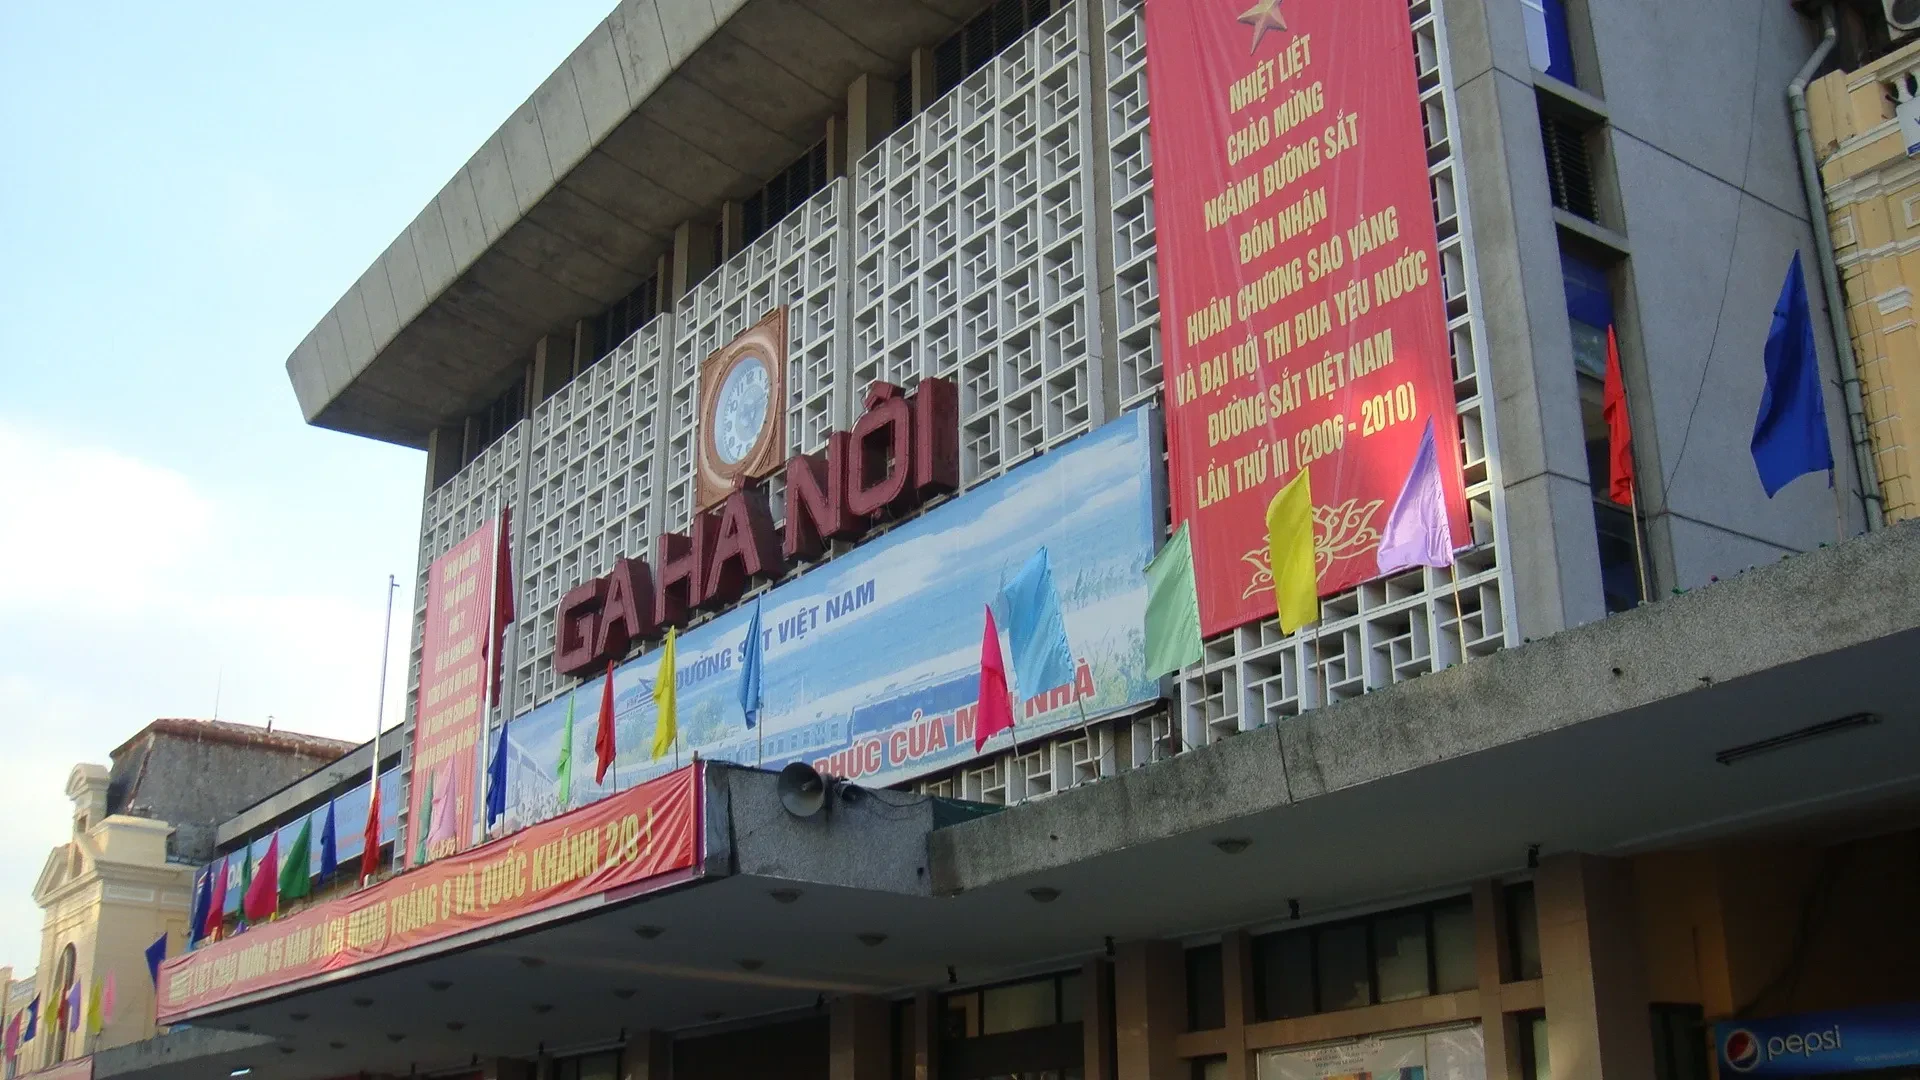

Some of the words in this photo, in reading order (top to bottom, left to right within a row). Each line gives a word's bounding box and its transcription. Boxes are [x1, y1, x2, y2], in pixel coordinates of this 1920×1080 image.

[1227, 115, 1270, 166] CHÀO
[1273, 81, 1324, 138] MỪNG
[1229, 59, 1274, 114] NHIỆT
[1278, 33, 1311, 83] LIỆT
[1204, 172, 1260, 232] NGÀNH
[1263, 136, 1321, 198] ĐƯỜNG
[1324, 108, 1358, 159] SẮT
[1187, 296, 1232, 347] HUÂN
[1237, 258, 1304, 322] CHƯƠNG
[1306, 234, 1344, 283] SAO
[1347, 205, 1399, 261] VÀNG
[1239, 217, 1276, 265] ĐÓN
[1278, 186, 1327, 244] NHẬN
[1175, 362, 1198, 407] VÀ
[1200, 352, 1229, 396] ĐẠI
[1232, 333, 1260, 381] HỘI
[1263, 320, 1292, 364] THI
[1294, 300, 1332, 349] ĐUA
[1334, 278, 1370, 327] YÊU
[1374, 246, 1429, 308] NƯỚC
[1208, 391, 1267, 448] ĐƯỜNG
[1268, 367, 1302, 419] SẮT
[1306, 350, 1345, 401] VIỆT
[1349, 327, 1394, 382] NAM
[1197, 457, 1231, 510] LẦN
[1233, 438, 1269, 493] THỨ
[1272, 438, 1290, 478] III
[1294, 414, 1344, 470] (2006
[1361, 381, 1417, 438] 2010)
[553, 557, 655, 678] GA
[655, 474, 784, 628] HÀ
[784, 376, 959, 561] NỘI
[737, 627, 773, 663] ST
[778, 605, 820, 645] VIỆT
[825, 579, 875, 624] NAM
[813, 740, 881, 778] PHÚC
[890, 710, 946, 763] CỦA
[391, 882, 438, 937] THÁNG
[441, 879, 451, 921] 8
[456, 863, 475, 914] VÀ
[480, 840, 527, 912] QUỐC
[532, 827, 600, 892] KHÁNH
[1767, 1025, 1841, 1060] pepsi
